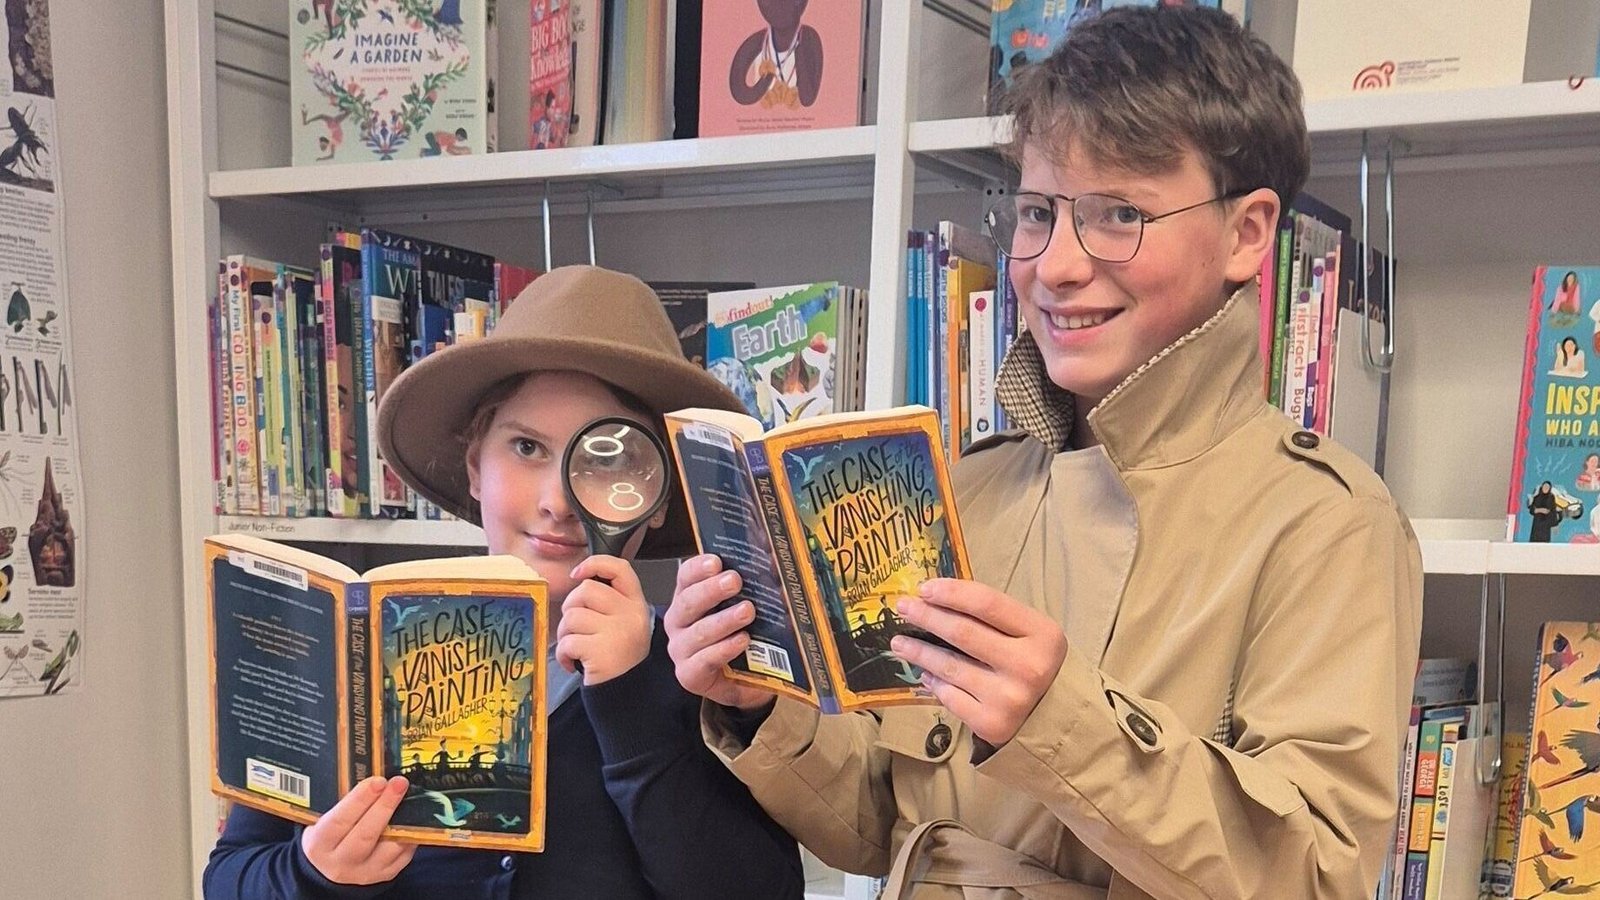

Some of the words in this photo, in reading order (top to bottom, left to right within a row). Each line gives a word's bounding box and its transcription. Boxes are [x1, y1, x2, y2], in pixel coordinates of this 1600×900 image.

[350, 50, 359, 64] A
[364, 49, 423, 64] GARDEN
[355, 32, 418, 47] IMAGINE
[383, 248, 400, 263] THE
[231, 290, 239, 305] My
[427, 270, 465, 304] TALES
[233, 307, 242, 331] First
[732, 303, 808, 361] Earth
[364, 338, 374, 388] WITCHES
[978, 359, 987, 406] HUMAN
[1290, 388, 1305, 421] Bugs
[1546, 419, 1582, 436] WHO
[1546, 438, 1574, 448] HIBA
[757, 476, 771, 494] THE
[801, 469, 844, 515] THE
[841, 441, 892, 494] CASE
[761, 493, 778, 517] CASE
[822, 454, 926, 550] VANISHING
[774, 532, 795, 581] VANISHING
[837, 488, 934, 592] PAINTING
[846, 580, 871, 609] BRIAN
[870, 547, 913, 589] GALLAGHER
[788, 580, 811, 625] PAINTING
[351, 617, 365, 633] THE
[352, 633, 366, 657] CASE
[391, 619, 429, 658] THE
[433, 599, 495, 645] CASE
[402, 617, 525, 692] VANISHING
[353, 671, 366, 716] VANISHING
[405, 648, 528, 730] PAINTING
[354, 716, 367, 756] PAINTING
[405, 721, 433, 747] BRIAN
[434, 697, 489, 732] GALLAGHER
[1403, 786, 1409, 794] TO
